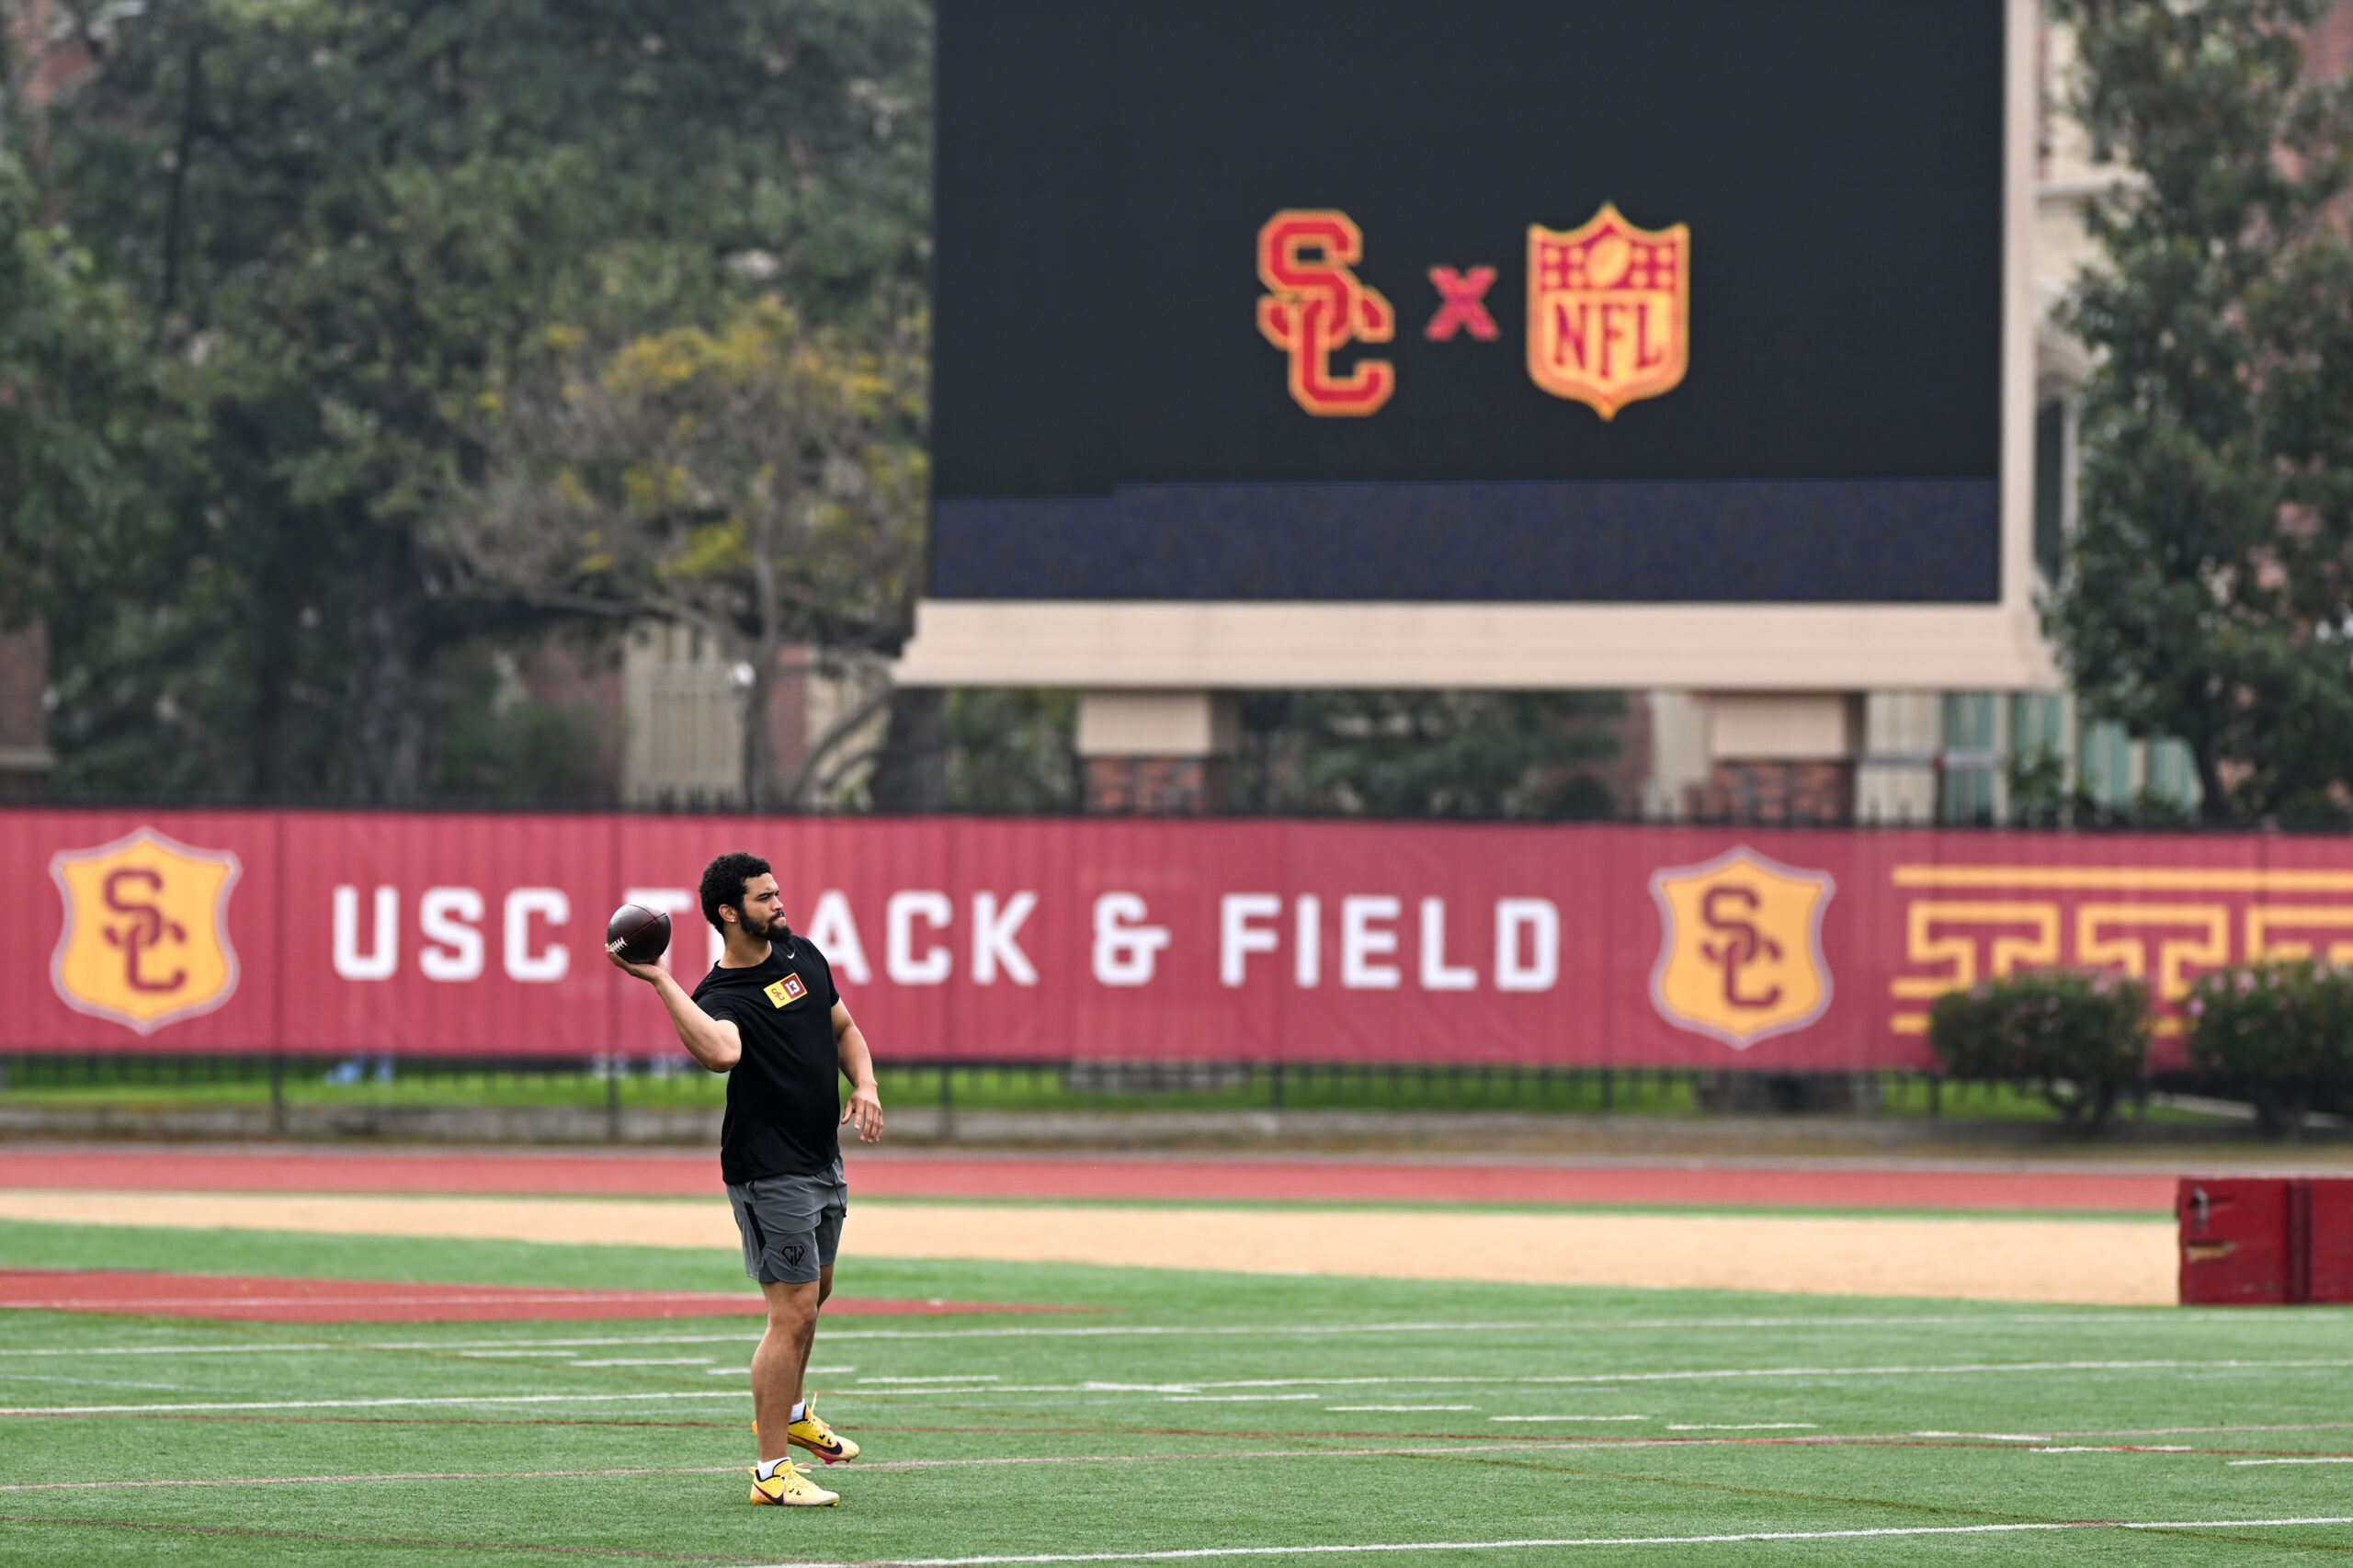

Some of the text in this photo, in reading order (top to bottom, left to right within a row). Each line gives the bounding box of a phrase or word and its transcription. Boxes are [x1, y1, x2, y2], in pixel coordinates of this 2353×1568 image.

[1256, 209, 1395, 417] SC
[1553, 301, 1664, 381] NFL
[101, 867, 188, 994] SC
[332, 884, 1561, 992] USC TACK & FIELD
[785, 980, 800, 994] 13
[1700, 885, 1782, 1009] SC
